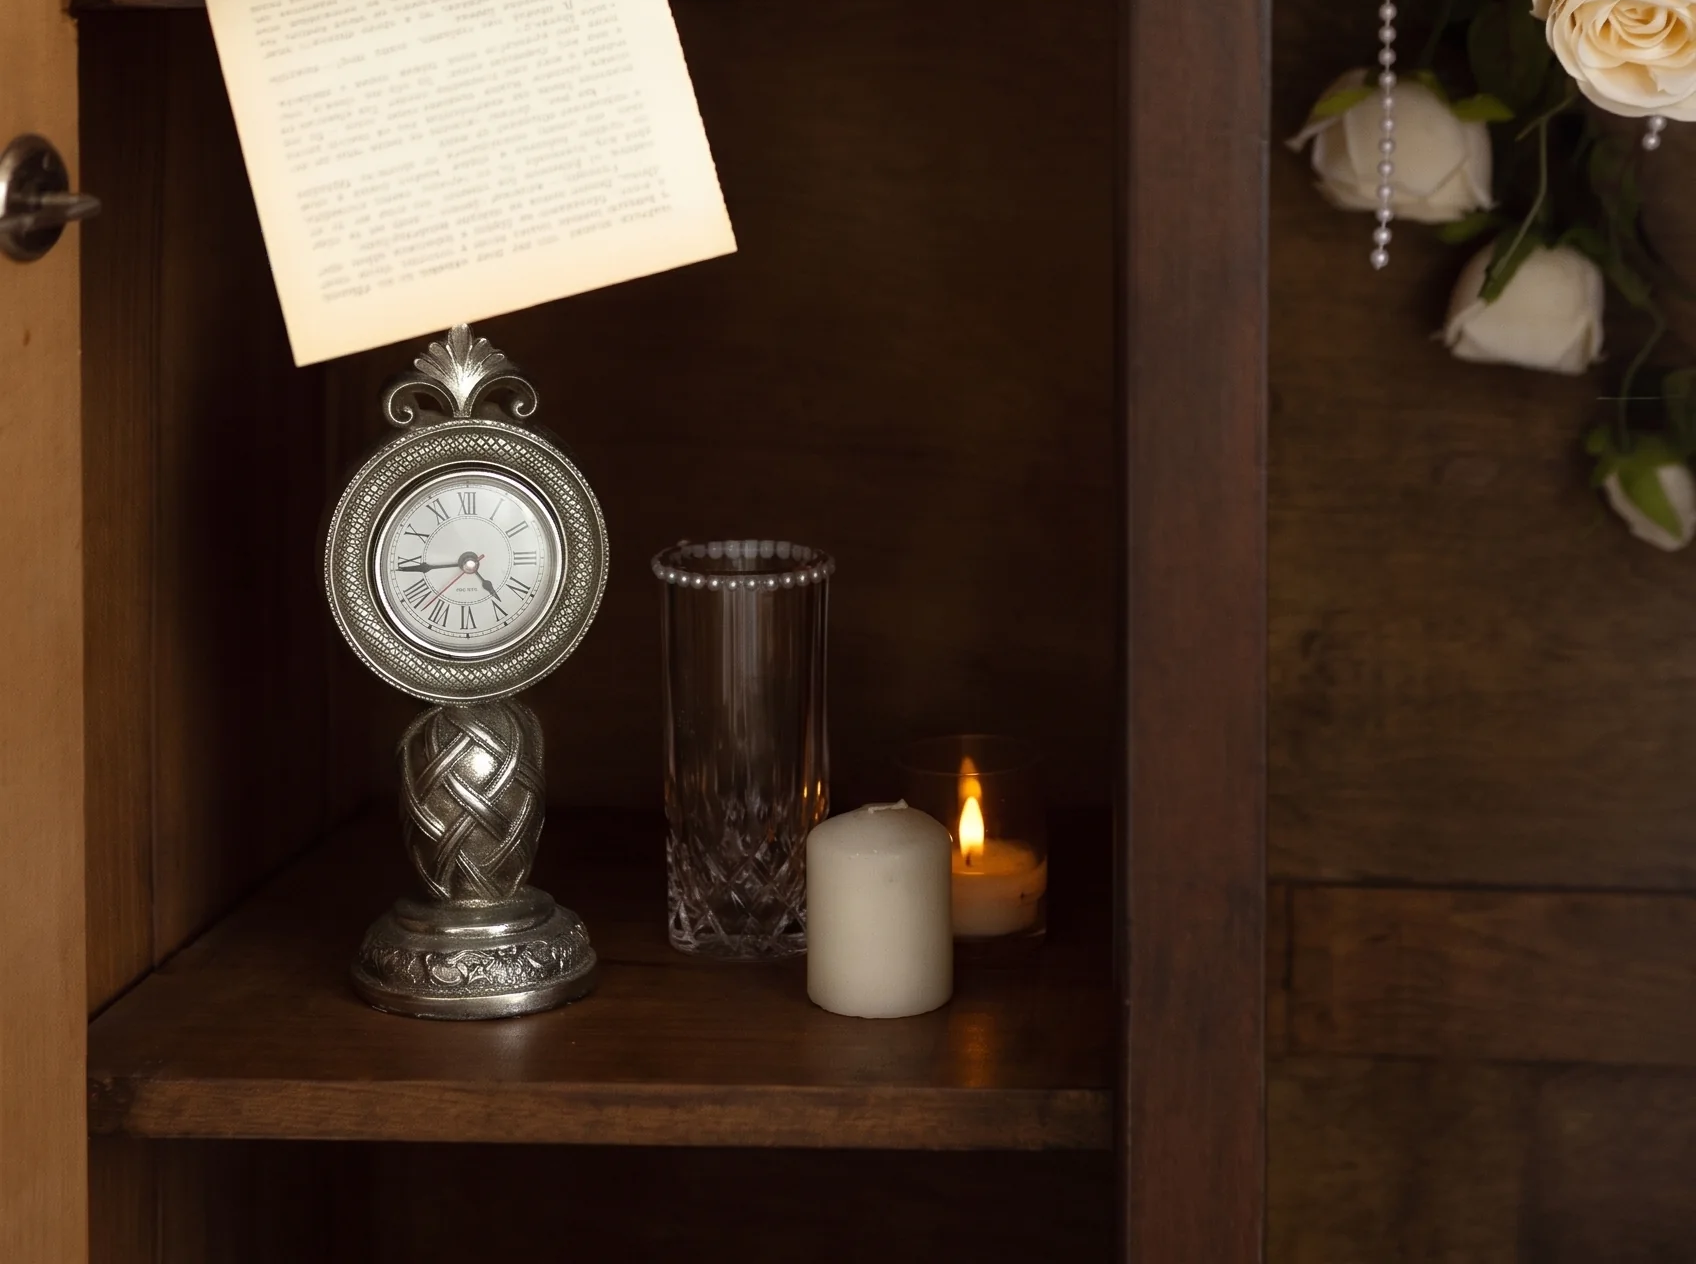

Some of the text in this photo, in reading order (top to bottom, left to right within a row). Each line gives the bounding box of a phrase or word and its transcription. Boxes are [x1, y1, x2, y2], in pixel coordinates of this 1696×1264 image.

[426, 498, 451, 526] XI
[457, 491, 478, 516] XII
[489, 498, 505, 521] I
[404, 523, 430, 544] X
[505, 520, 529, 538] II
[397, 555, 422, 570] X
[513, 550, 538, 566] III
[402, 578, 433, 609] VIII
[505, 576, 531, 601] IV
[427, 598, 451, 628] VII
[459, 605, 477, 630] VI
[491, 599, 509, 622] V
